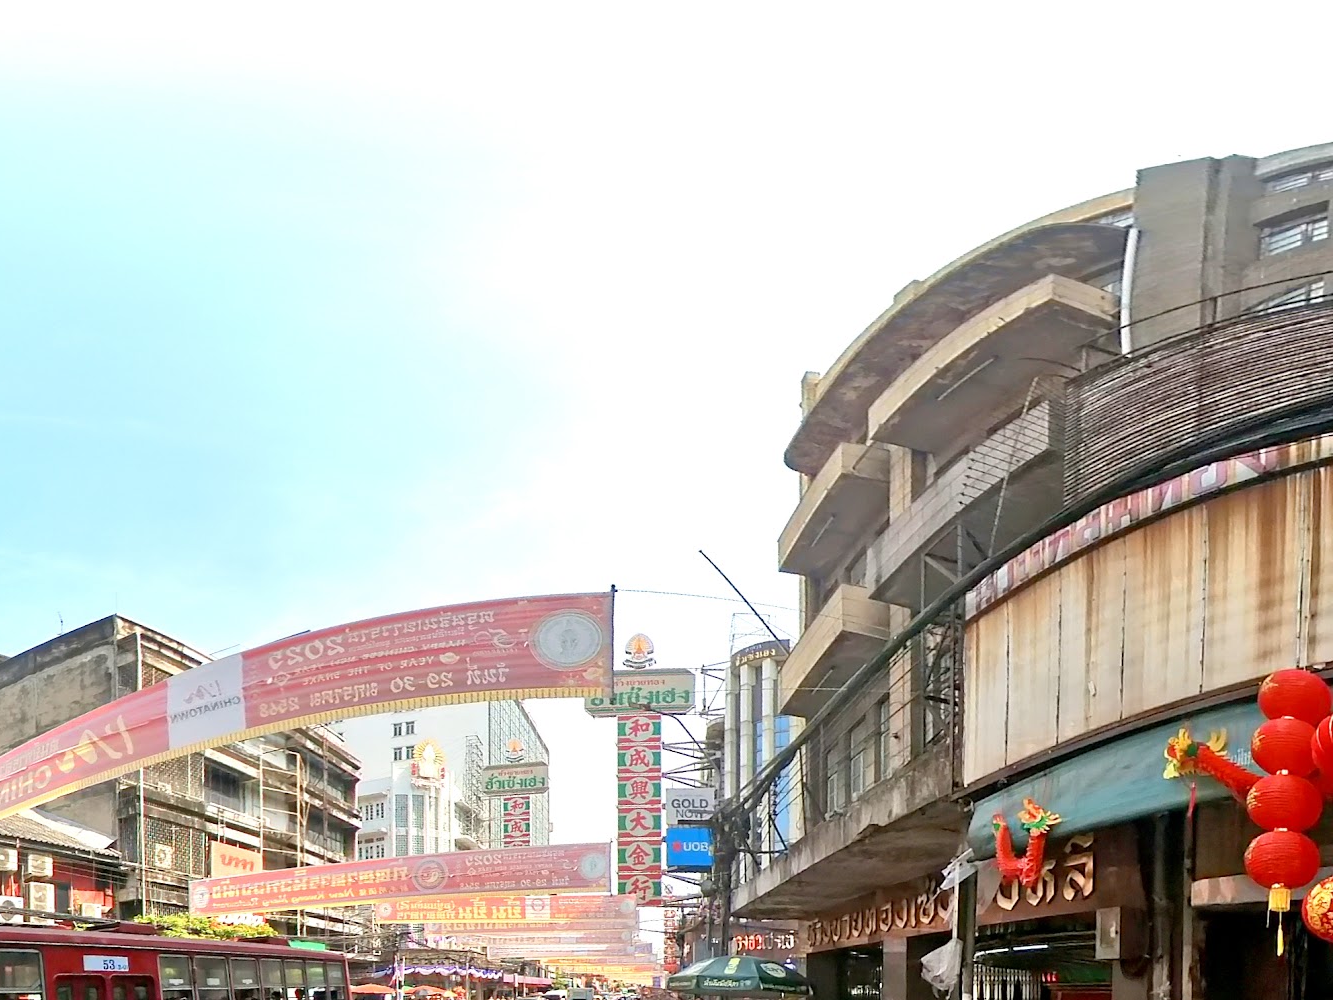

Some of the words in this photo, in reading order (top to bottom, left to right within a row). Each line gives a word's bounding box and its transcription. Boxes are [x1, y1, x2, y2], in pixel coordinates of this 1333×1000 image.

[628, 717, 652, 901] 和成興大金行
[670, 798, 709, 809] GOLD
[683, 842, 709, 852] UOB
[103, 959, 115, 970] 53
